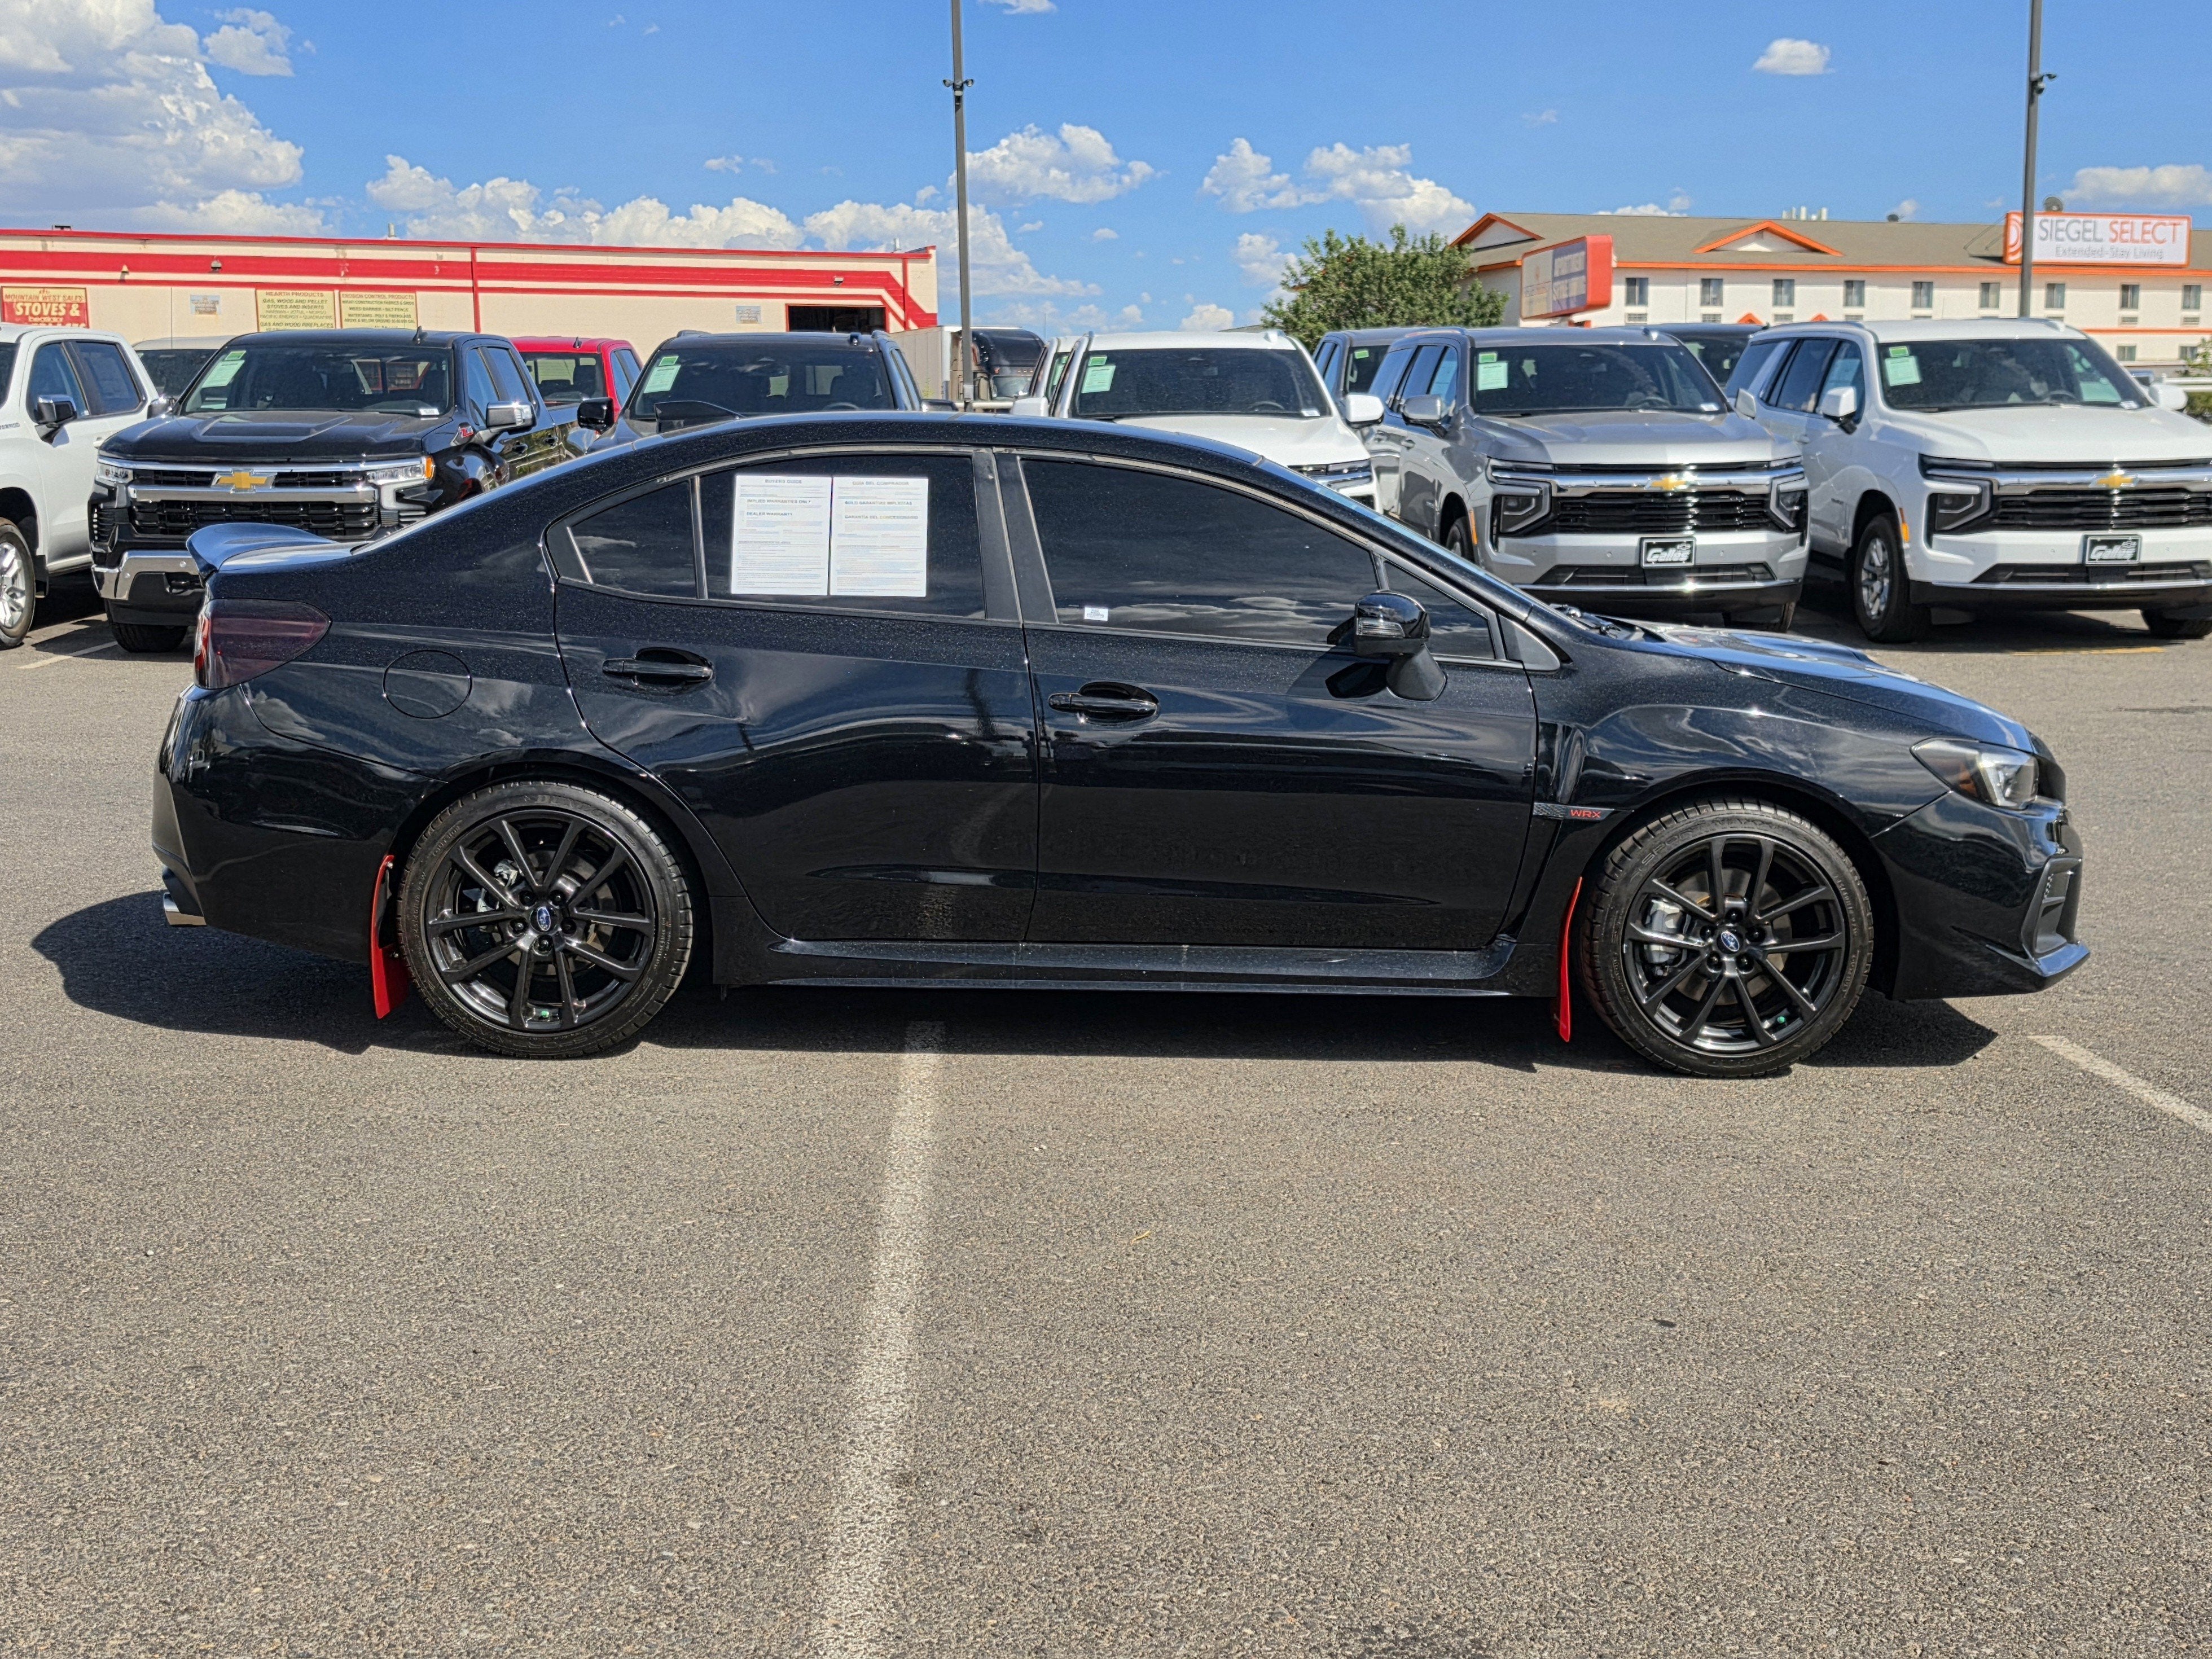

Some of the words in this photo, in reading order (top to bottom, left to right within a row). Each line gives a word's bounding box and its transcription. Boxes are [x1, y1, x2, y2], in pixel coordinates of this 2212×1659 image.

[2039, 218, 2103, 243] SIEGEL
[2108, 220, 2182, 245] SELECT
[2134, 245, 2163, 261] Living
[15, 302, 67, 316] STOVES
[69, 303, 80, 317] &
[1647, 547, 1691, 562] Galles
[2090, 545, 2136, 560] Galles
[1570, 809, 1601, 818] WRX
